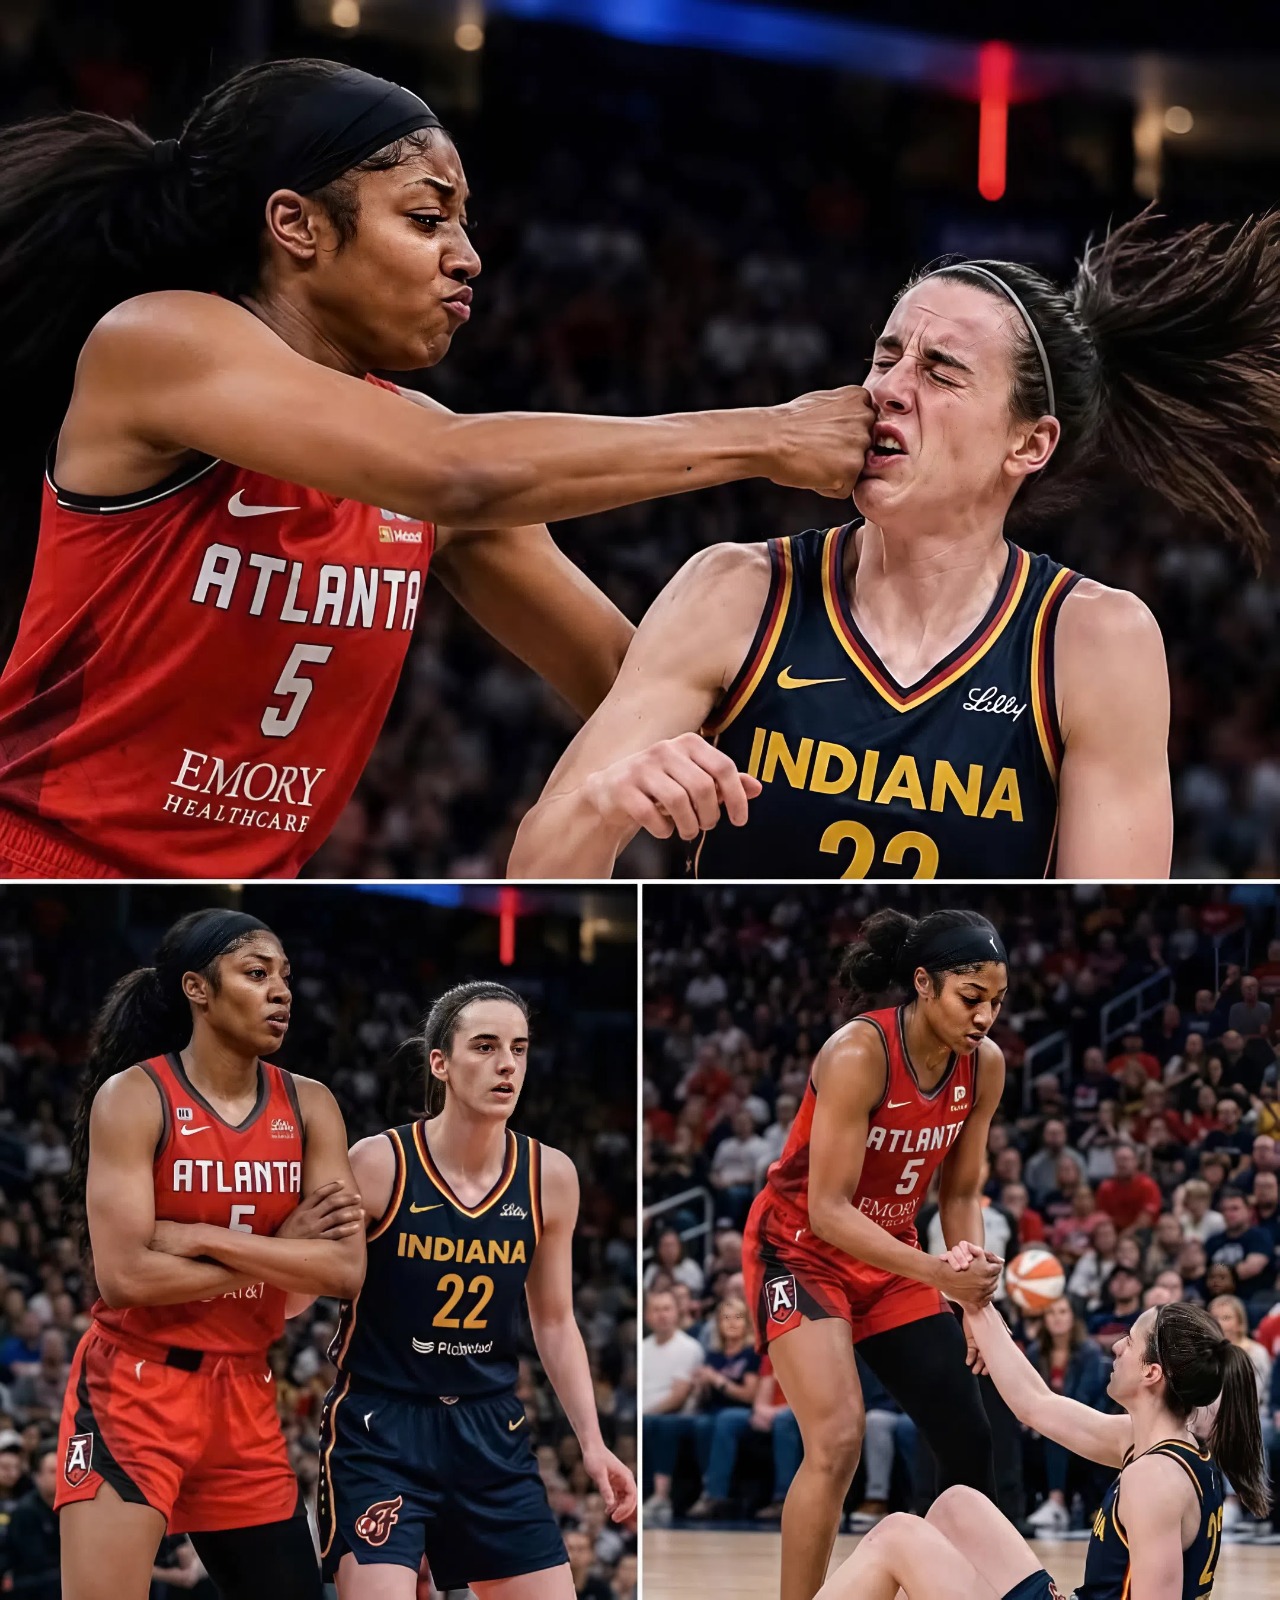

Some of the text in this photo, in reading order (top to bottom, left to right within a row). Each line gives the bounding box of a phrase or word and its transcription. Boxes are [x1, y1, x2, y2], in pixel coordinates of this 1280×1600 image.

[191, 543, 421, 631] ATLANTA
[260, 643, 334, 738] 5
[963, 686, 1027, 722] Lilly
[170, 748, 326, 807] EMORY
[747, 726, 1024, 822] INDIANA
[162, 794, 310, 833] HEALTHCARE
[172, 1159, 301, 1193] ATLANTA
[895, 1158, 926, 1195] 5
[397, 1232, 527, 1265] INDIANA
[432, 1273, 495, 1329] 22
